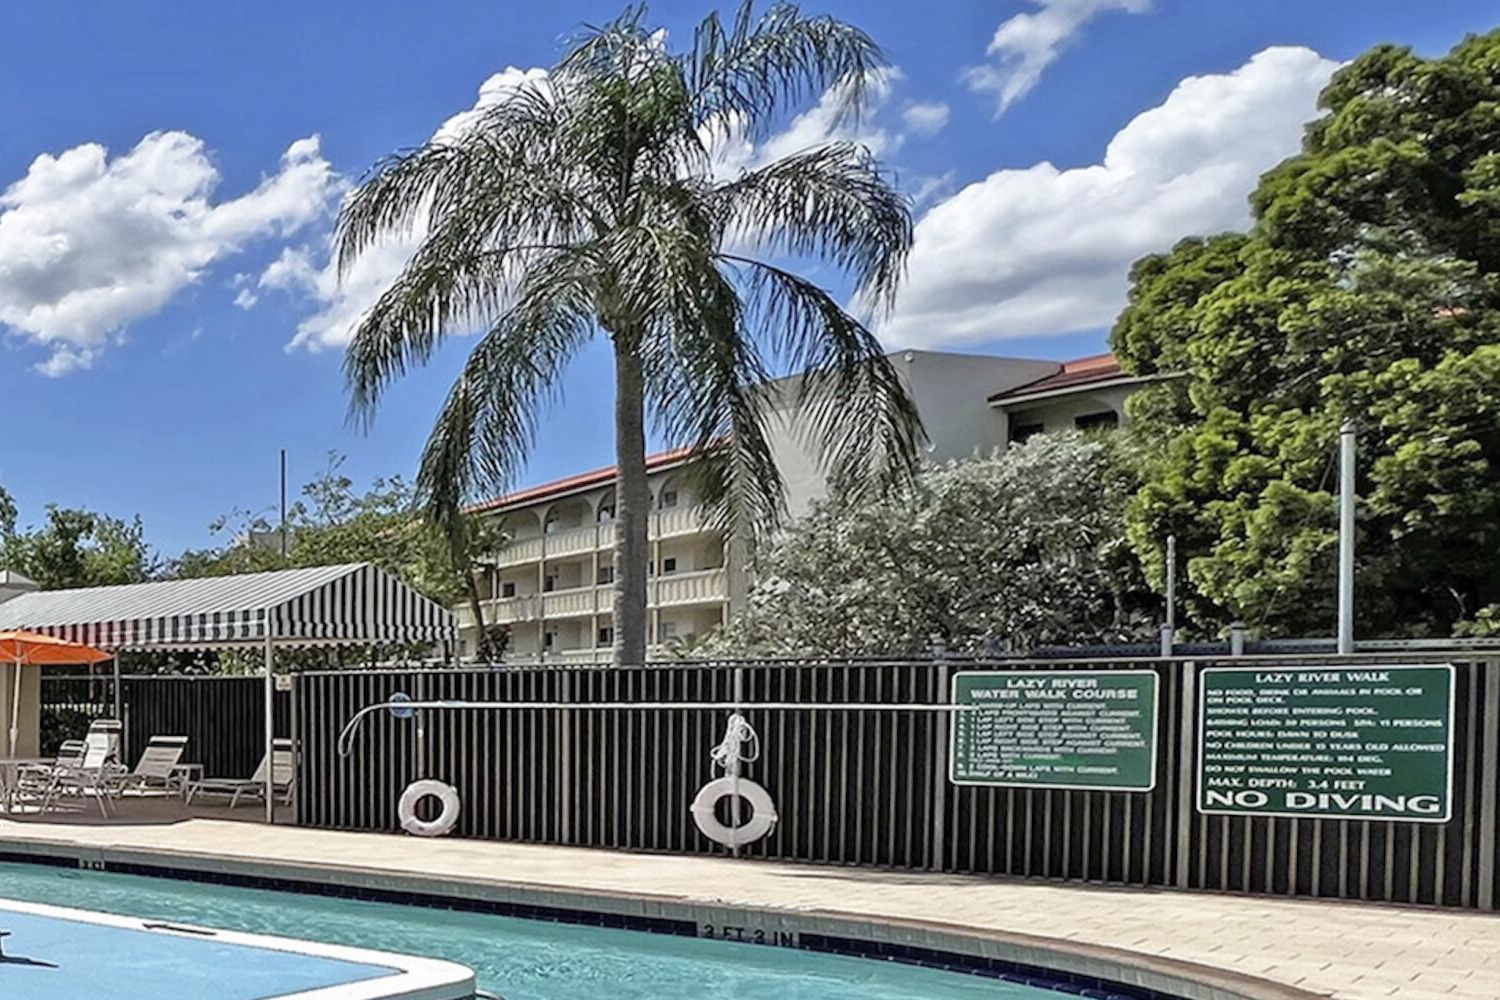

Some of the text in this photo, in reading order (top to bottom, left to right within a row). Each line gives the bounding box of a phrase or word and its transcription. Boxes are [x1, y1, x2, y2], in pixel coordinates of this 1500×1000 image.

[1255, 672, 1390, 683] LAZY RIVER WALK
[1007, 679, 1097, 688] LAZY RIVER
[971, 689, 1138, 699] WATER WALK COURSE
[1251, 707, 1289, 715] BEFORE
[1292, 707, 1343, 715] ENTERING
[1345, 707, 1378, 715] POOL.
[1224, 742, 1274, 750] CHILDREN
[1392, 744, 1445, 752] ALLOWED
[1357, 755, 1384, 763] DEG.
[1357, 768, 1392, 776] WATER
[1208, 778, 1244, 786] MAX.
[1248, 778, 1297, 788] DEPTH:
[1334, 780, 1366, 790] FEET
[1206, 790, 1440, 813] NO DIVING
[723, 926, 744, 941] FT
[774, 931, 793, 947] IN
